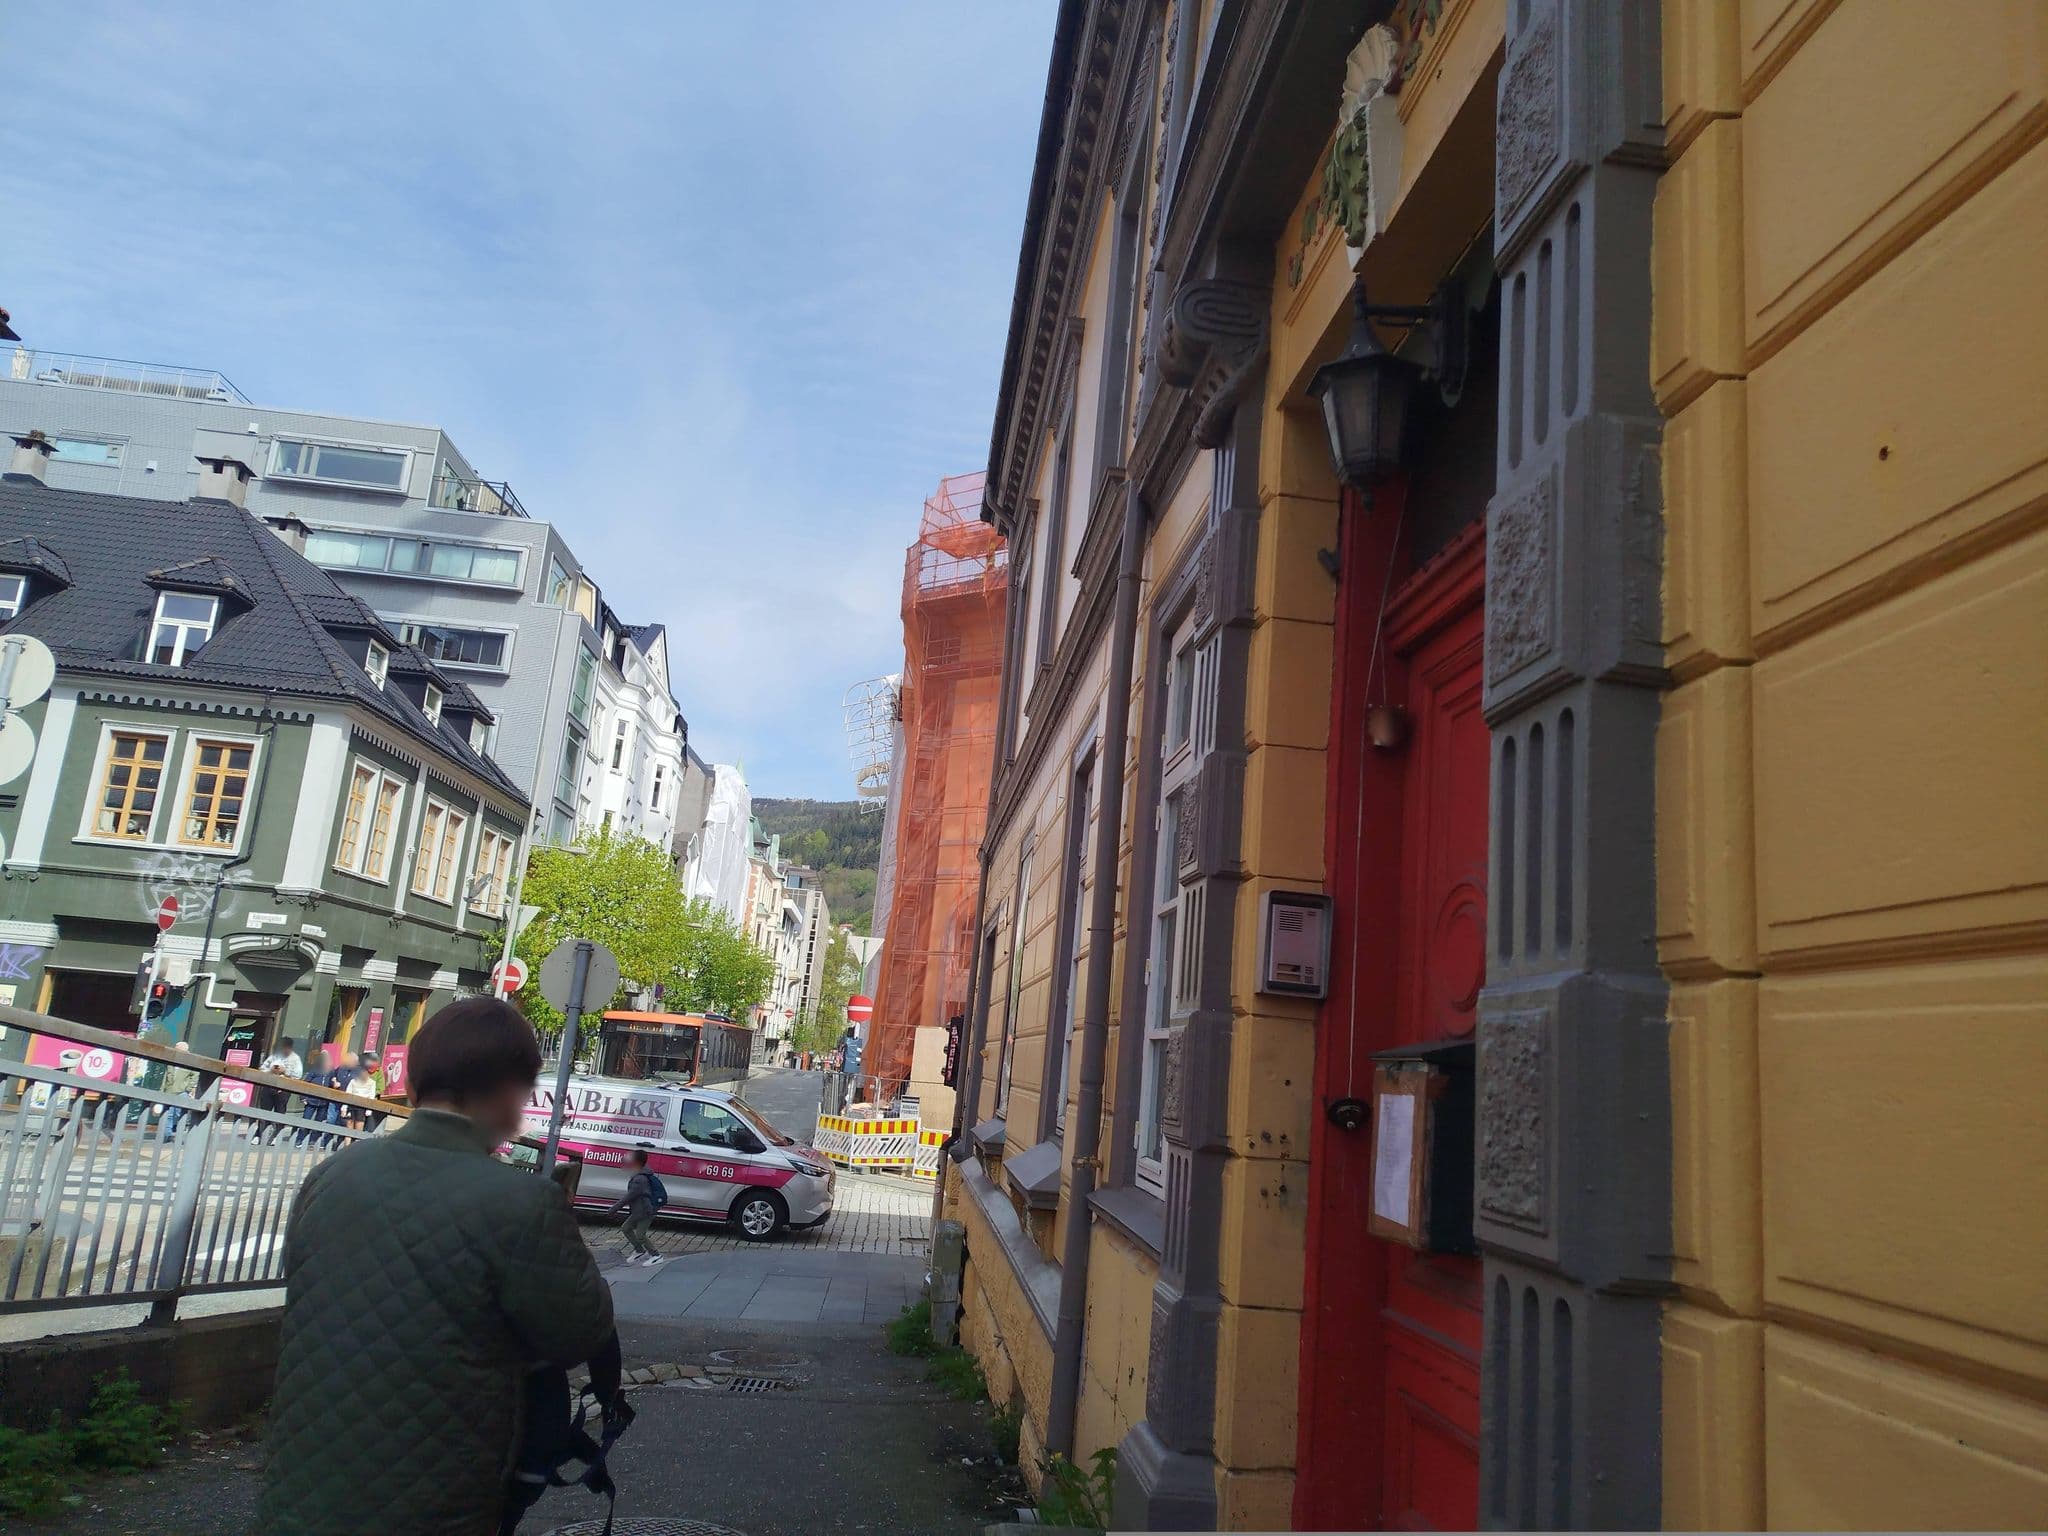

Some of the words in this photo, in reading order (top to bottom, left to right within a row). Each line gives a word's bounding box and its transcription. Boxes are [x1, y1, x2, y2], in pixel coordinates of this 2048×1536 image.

[523, 1089, 575, 1111] ANA
[581, 1089, 667, 1120] BLIKK
[706, 1164, 719, 1176] 69
[721, 1166, 734, 1178] 69
